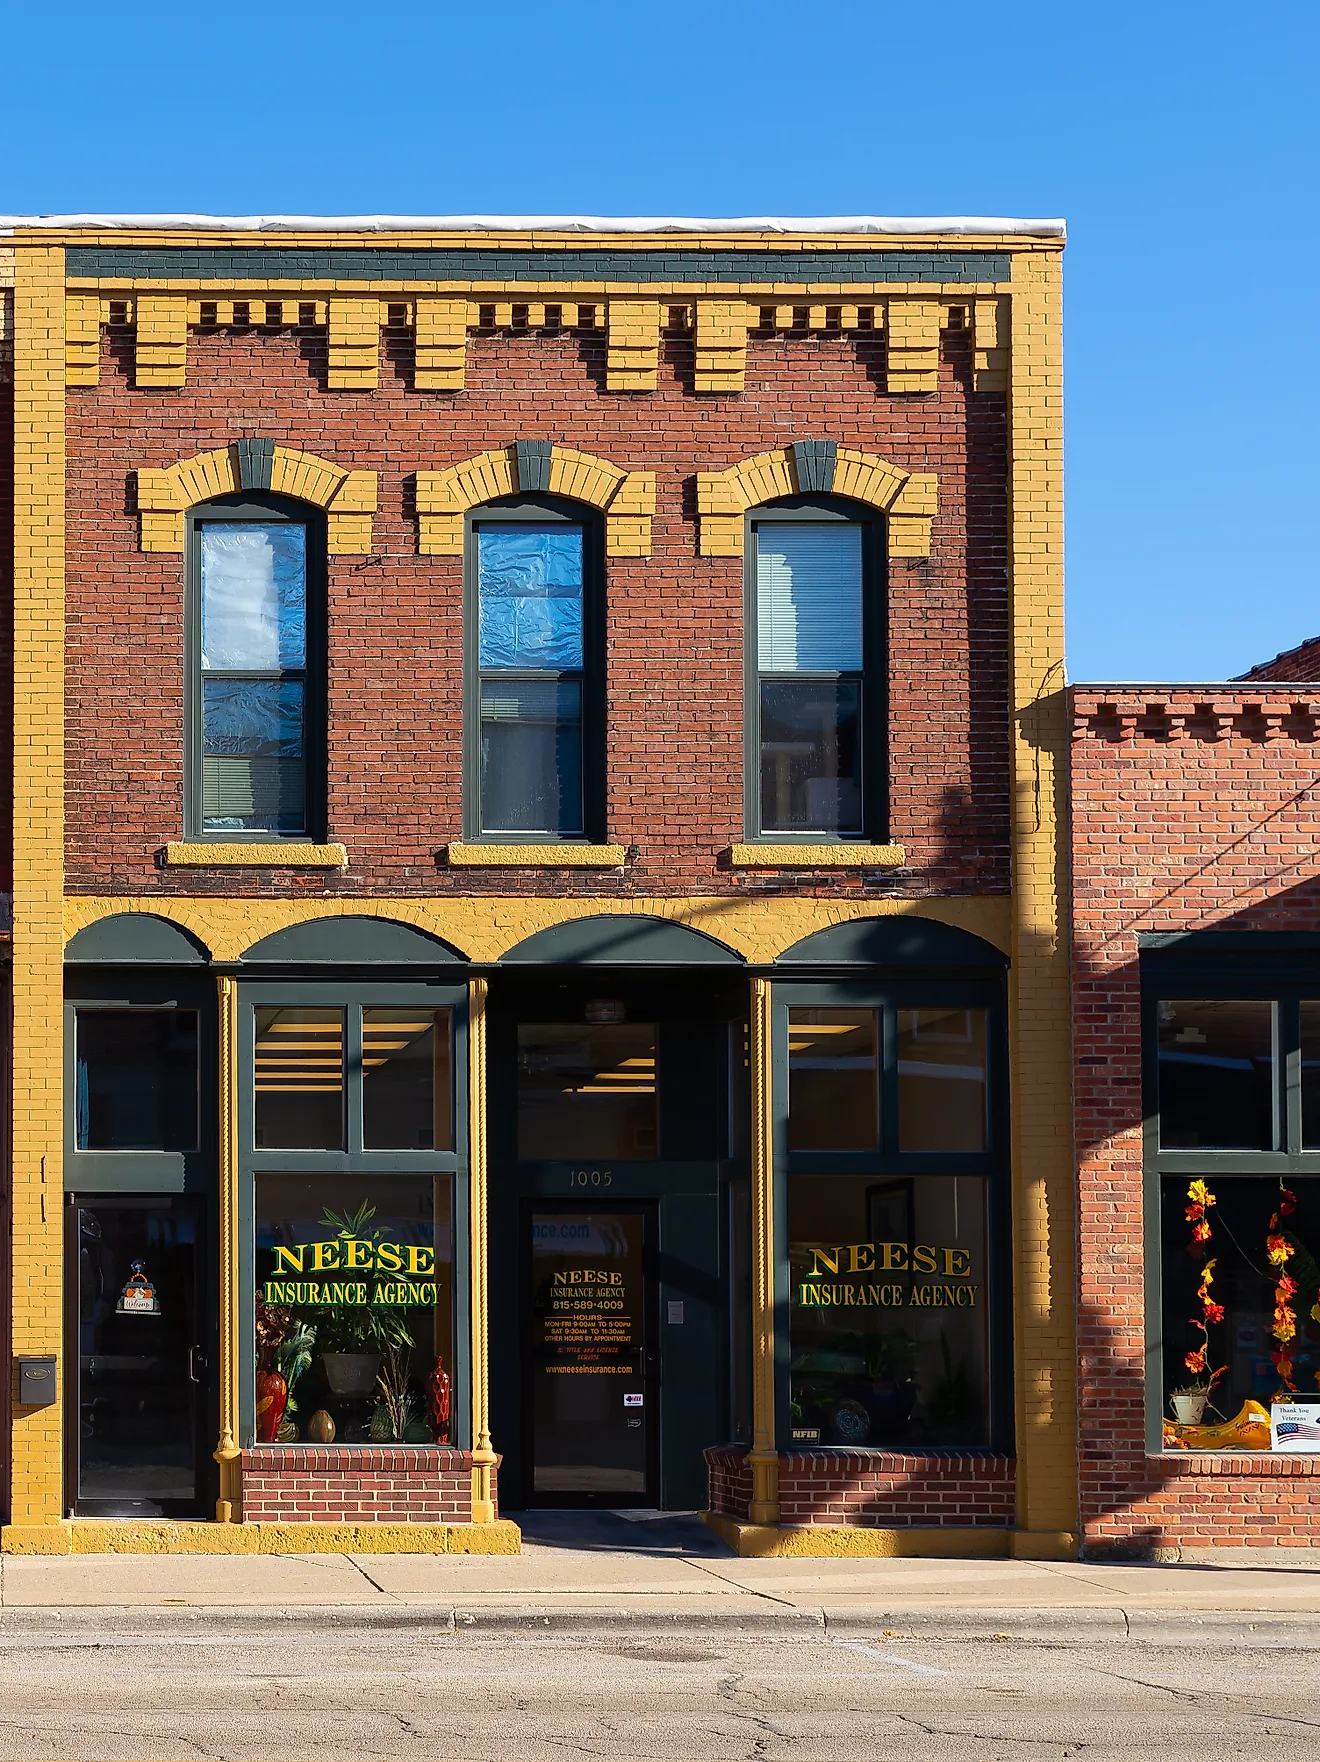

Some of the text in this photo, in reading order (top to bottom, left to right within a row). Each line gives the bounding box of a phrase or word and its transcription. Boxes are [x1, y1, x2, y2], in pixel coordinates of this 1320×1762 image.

[569, 1170, 613, 1187] 1005
[271, 1239, 435, 1276] NEESE
[806, 1242, 971, 1278] NEESE
[553, 1270, 623, 1286] NEESE
[264, 1282, 442, 1306] INSURANCE AGENCY
[550, 1287, 625, 1298] INSURANCE AGENCY
[799, 1283, 978, 1307] INSURANCE AGENCY
[126, 1299, 151, 1309] Welcome
[792, 1430, 817, 1438] NFIB
